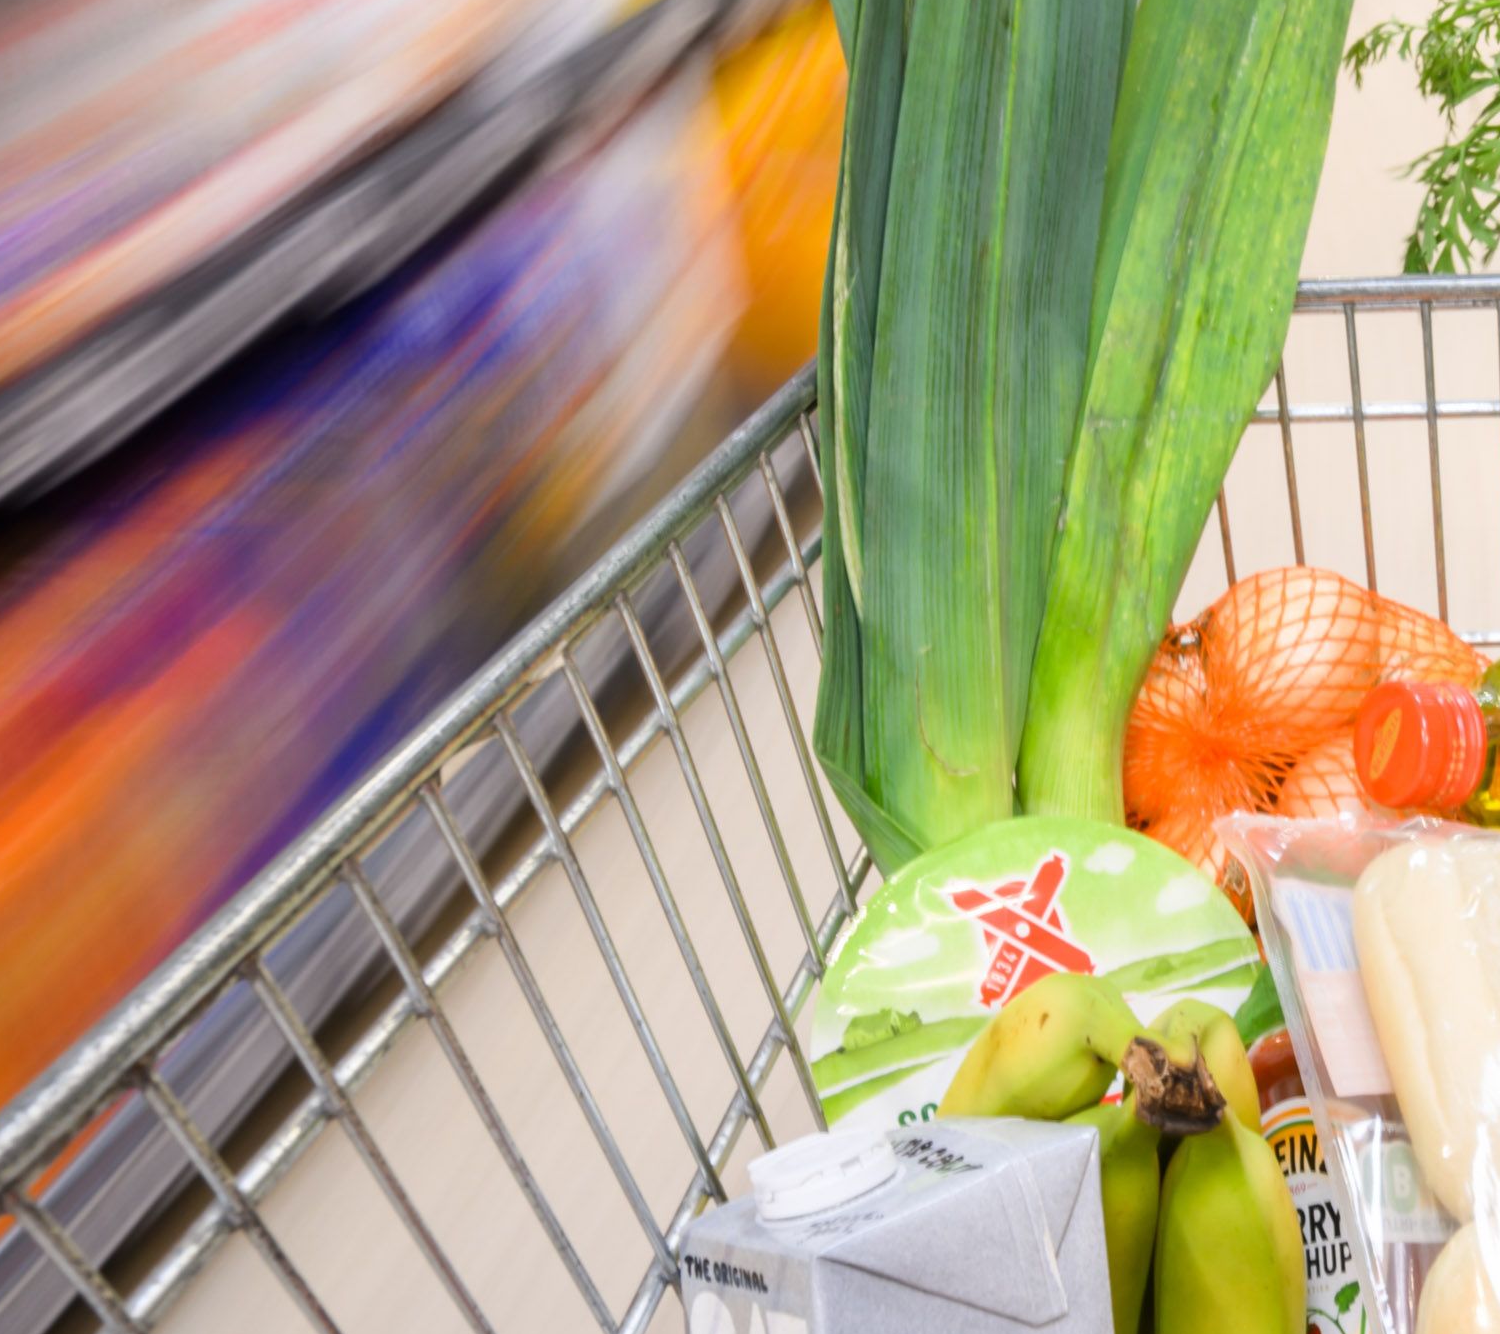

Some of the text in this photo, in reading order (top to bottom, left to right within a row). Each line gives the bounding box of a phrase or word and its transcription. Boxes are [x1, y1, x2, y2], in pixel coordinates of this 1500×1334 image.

[986, 950, 1017, 993] 1834
[1274, 1134, 1328, 1177] EIN
[685, 1255, 768, 1293] THE ORIGINAL
